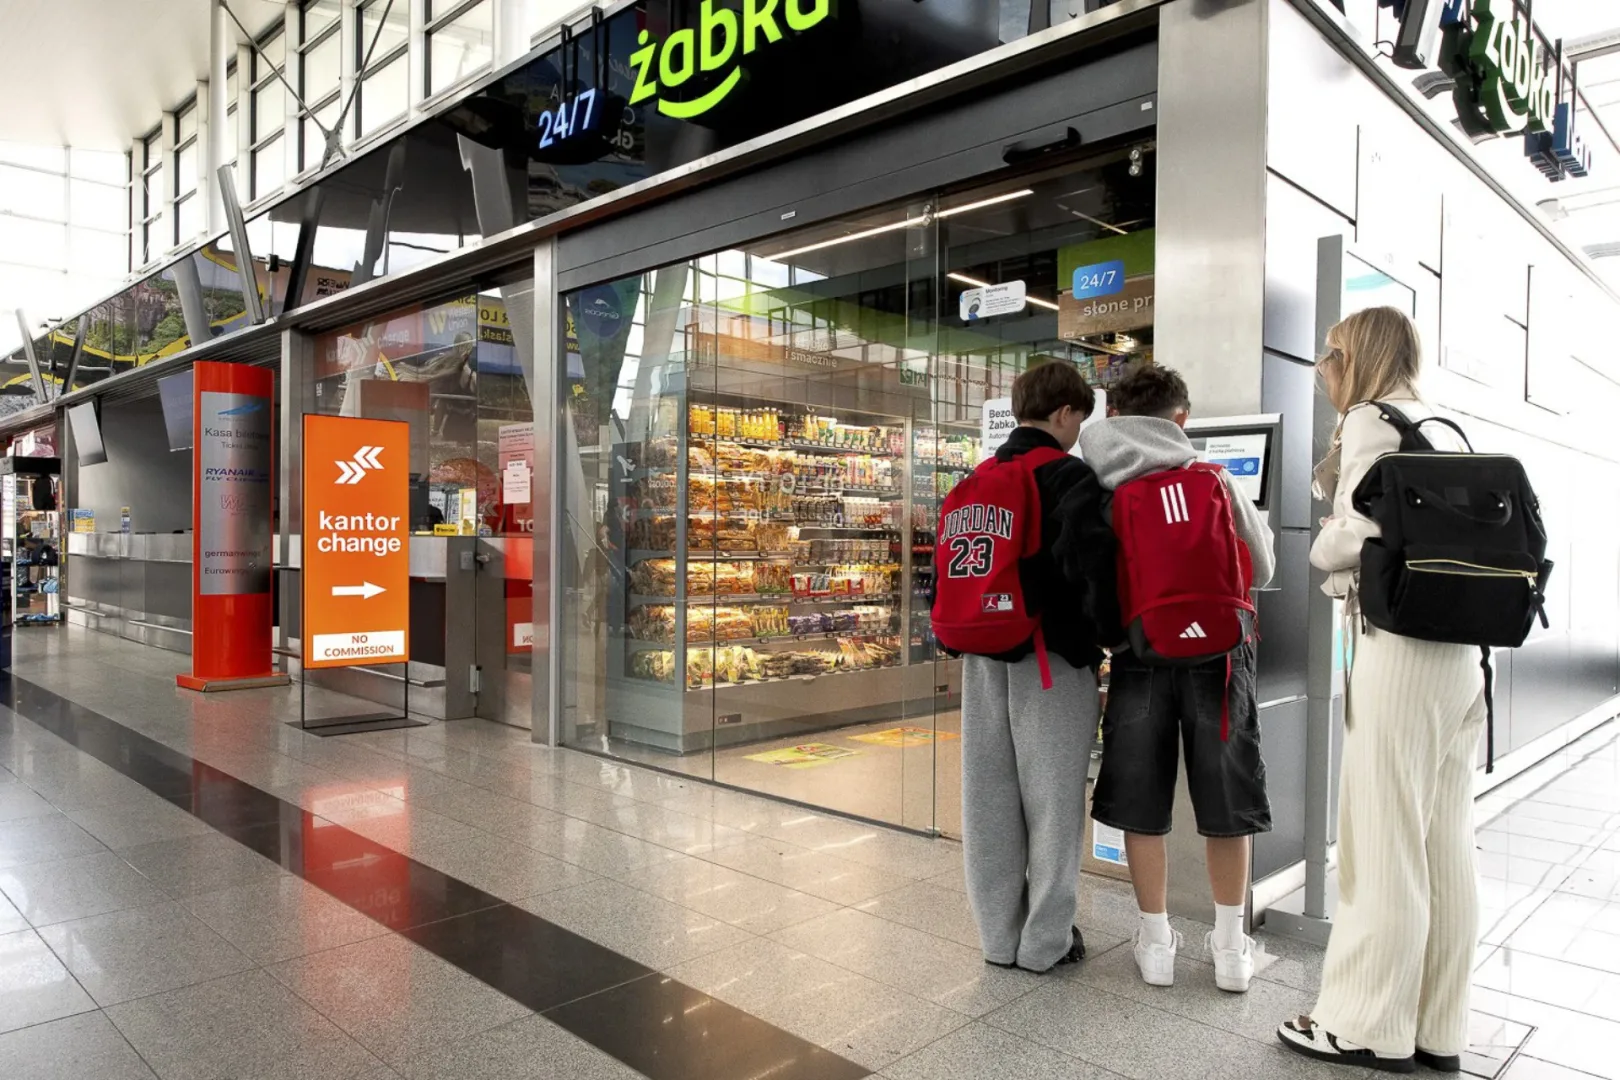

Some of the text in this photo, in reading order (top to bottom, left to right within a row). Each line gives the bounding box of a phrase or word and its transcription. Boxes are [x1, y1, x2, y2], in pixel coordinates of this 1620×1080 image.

[538, 87, 596, 149] 24/7
[1080, 270, 1116, 290] 24/7
[1083, 295, 1152, 317] słone pr
[785, 347, 838, 368] i smacznie
[204, 427, 233, 437] Kasa
[989, 419, 1016, 430] Żabka
[205, 467, 256, 476] RYANAIR
[319, 510, 400, 531] kantor
[940, 503, 1014, 545] JORDAN
[317, 532, 401, 557] change
[204, 551, 261, 559] germanwings
[948, 535, 994, 578] 23
[351, 634, 368, 644] NO
[324, 645, 394, 658] COMMISSION
